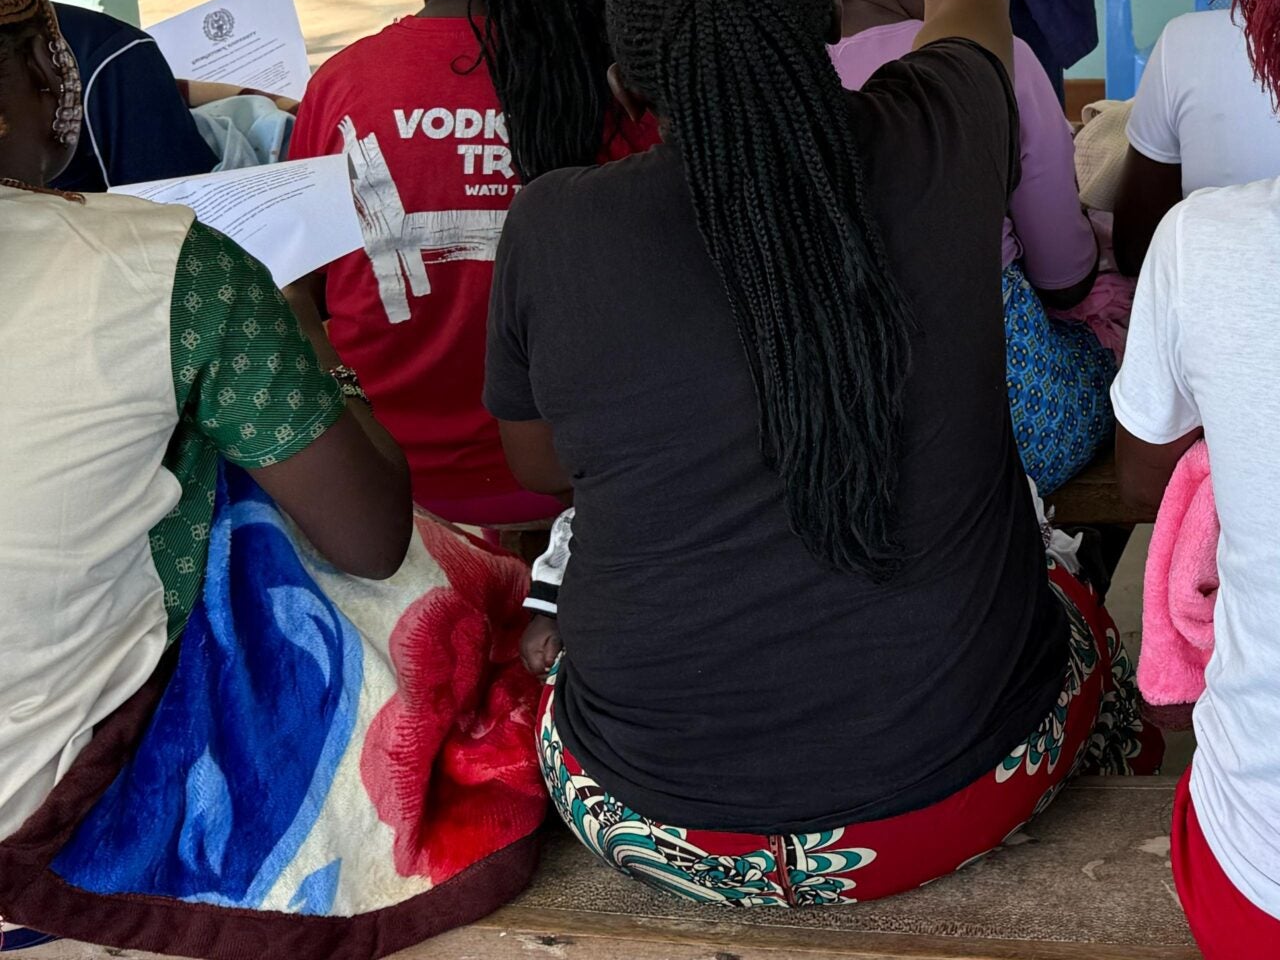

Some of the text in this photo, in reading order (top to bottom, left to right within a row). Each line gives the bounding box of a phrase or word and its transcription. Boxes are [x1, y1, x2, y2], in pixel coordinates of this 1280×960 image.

[393, 108, 510, 144] VODK
[457, 144, 516, 179] TR
[464, 184, 508, 196] WATU
